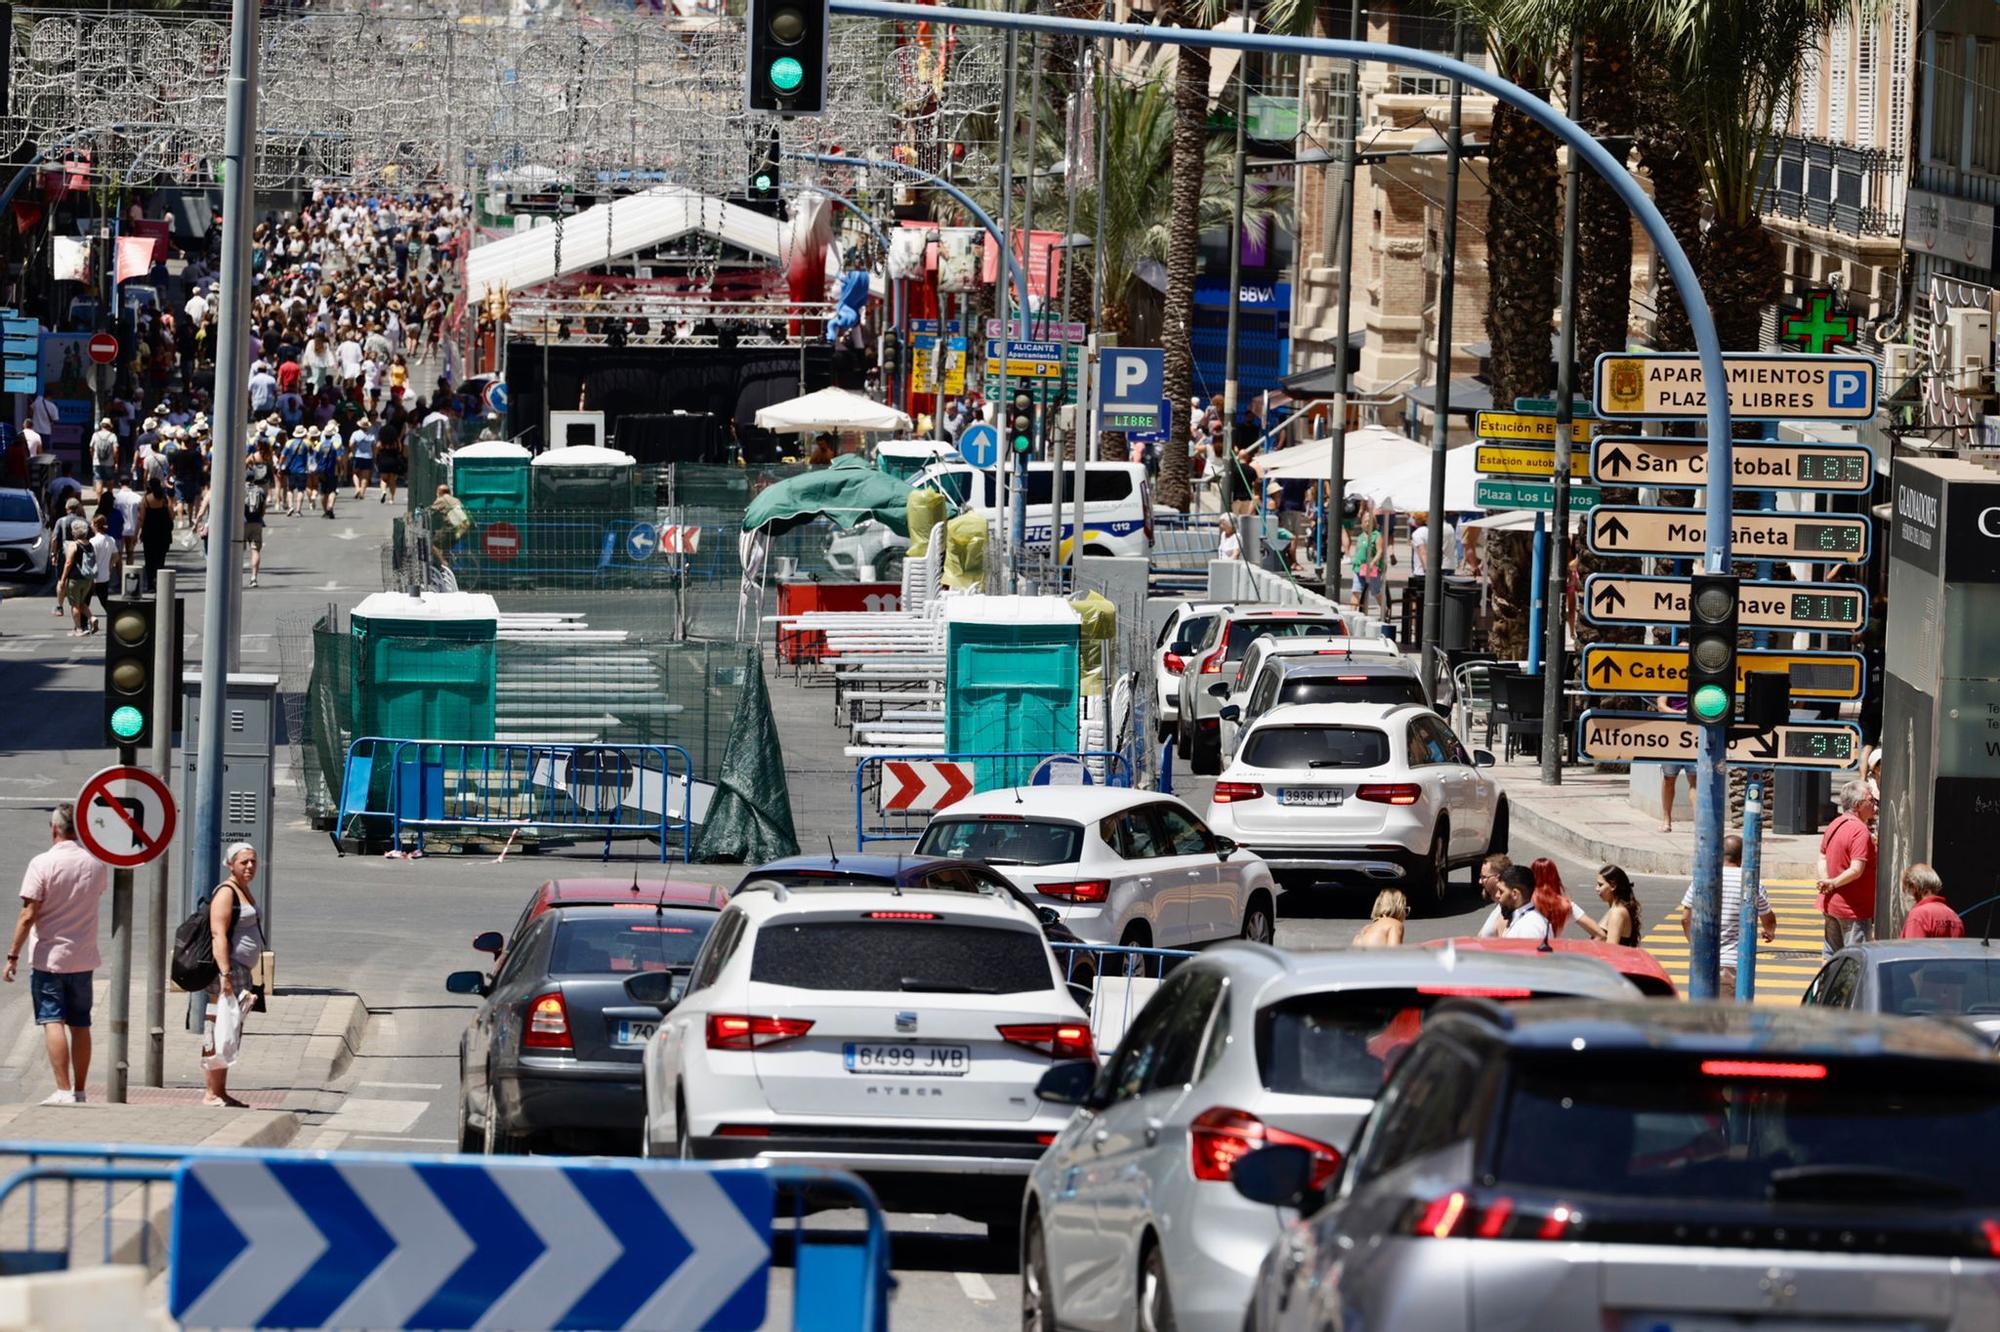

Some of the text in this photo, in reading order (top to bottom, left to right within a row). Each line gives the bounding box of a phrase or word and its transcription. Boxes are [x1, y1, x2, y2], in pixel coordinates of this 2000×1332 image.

[1239, 286, 1275, 302] BBVA
[1013, 344, 1055, 352] ALICANTE
[1650, 367, 1825, 384] APARMIENTOS
[1660, 391, 1814, 408] PLAZS LIBRES
[1115, 416, 1153, 427] LIBRE
[1480, 420, 1580, 435] Estación REE
[1480, 455, 1577, 469] Estación autobs
[1636, 453, 1791, 476] San Ctobal
[1803, 457, 1863, 480] 185
[1479, 488, 1593, 505] Plaza Los Lros
[1668, 524, 1788, 545] Moañeta
[1820, 527, 1859, 549] 69
[1654, 592, 1786, 614] Mainave
[1794, 596, 1852, 620] 311
[1629, 662, 1688, 680] Cated
[1589, 728, 1669, 748] Alfonso
[1286, 790, 1340, 801] 3936 KTY
[860, 1047, 963, 1068] 6499 JVB
